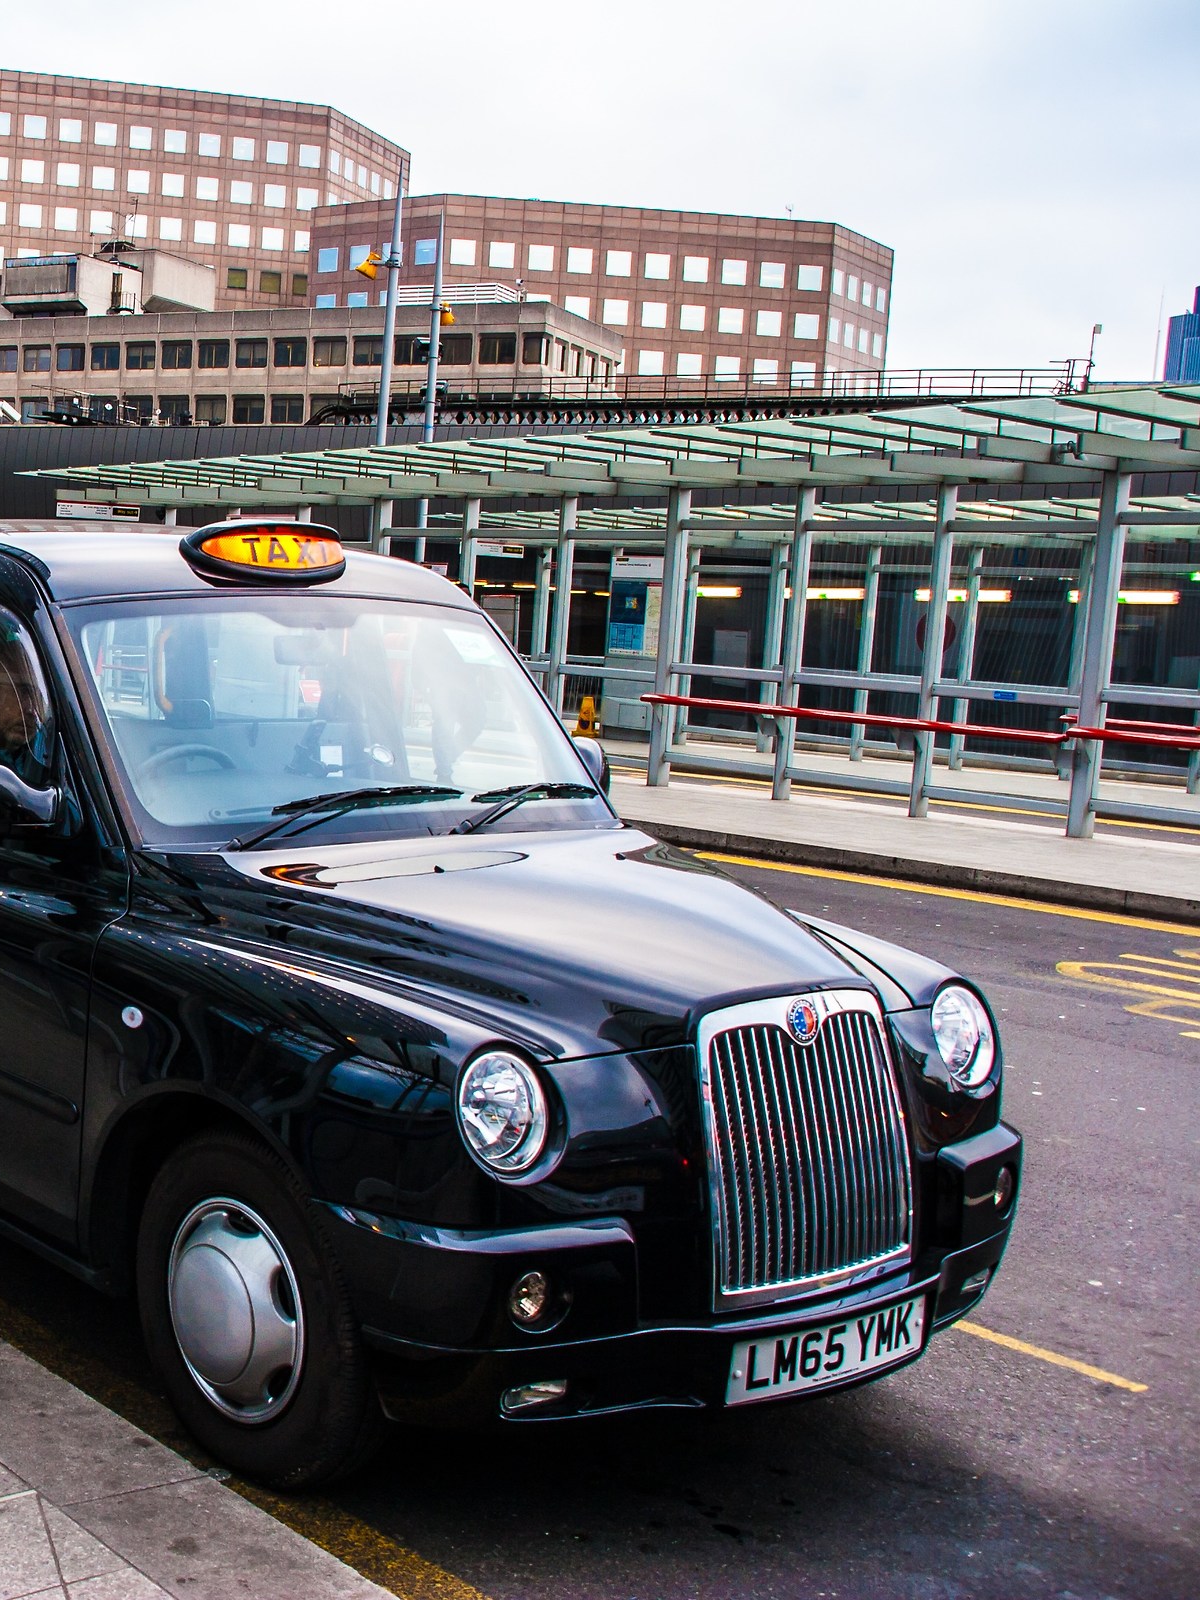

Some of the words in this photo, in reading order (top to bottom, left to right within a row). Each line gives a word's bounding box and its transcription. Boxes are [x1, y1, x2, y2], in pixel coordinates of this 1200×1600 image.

[242, 537, 328, 565] TAXI
[745, 1324, 847, 1391] LM65
[856, 1301, 914, 1362] YMK
